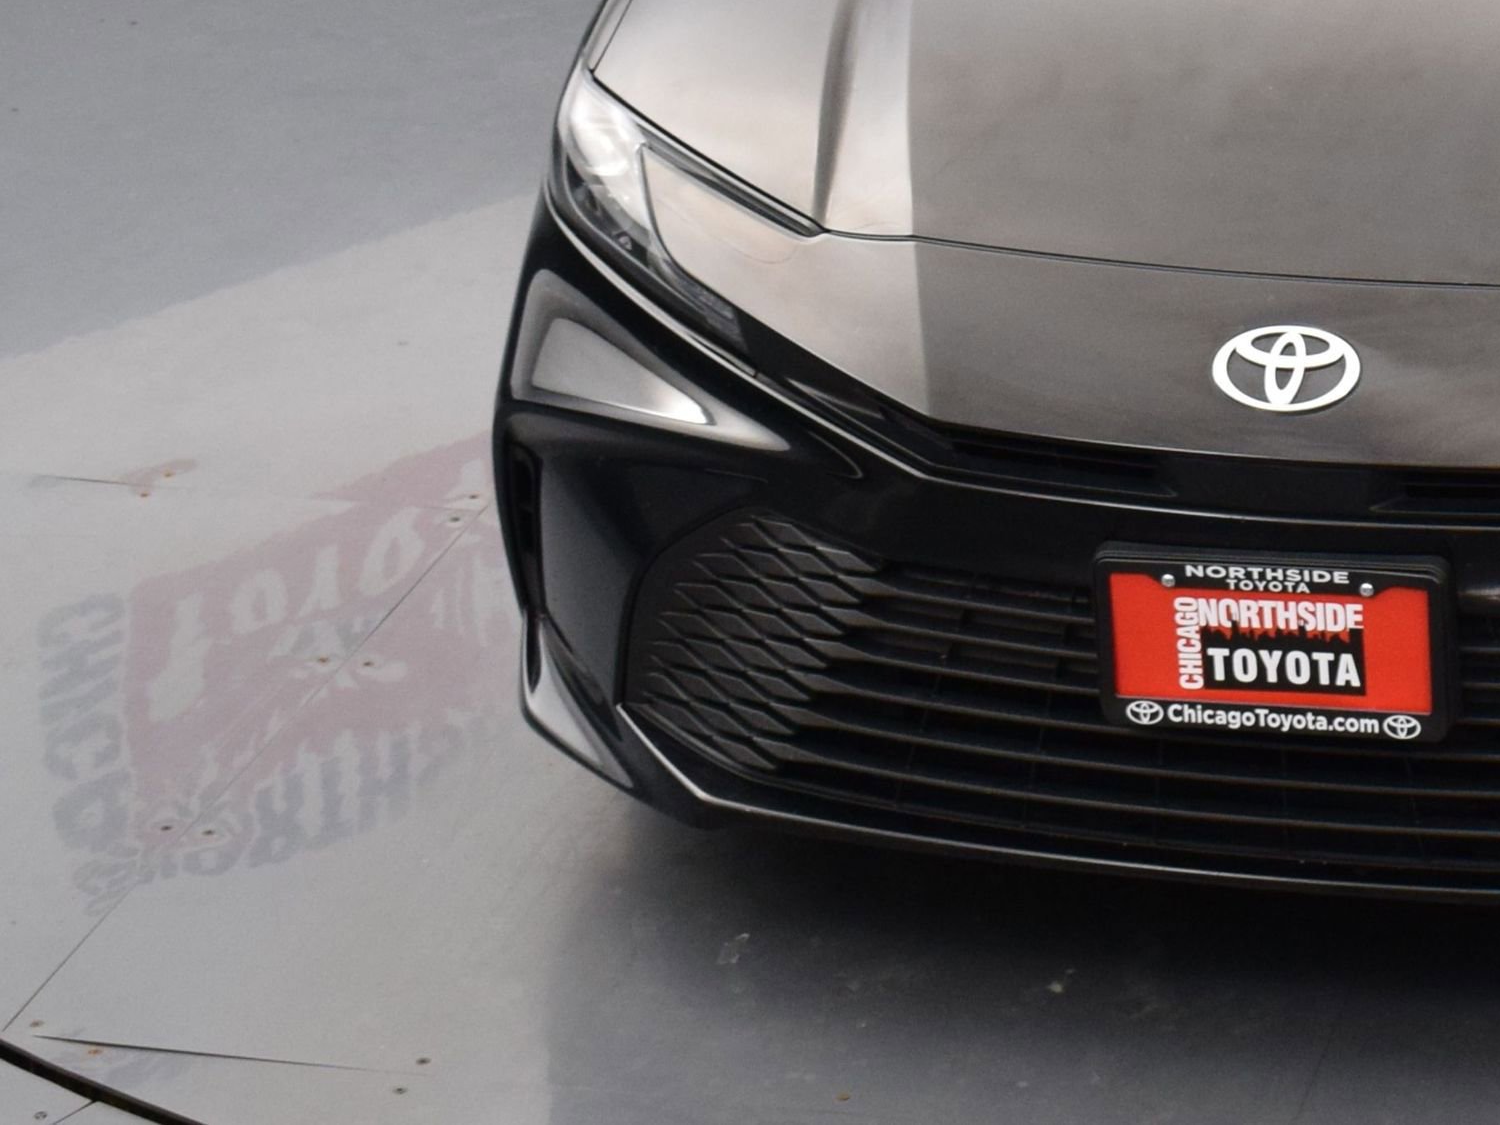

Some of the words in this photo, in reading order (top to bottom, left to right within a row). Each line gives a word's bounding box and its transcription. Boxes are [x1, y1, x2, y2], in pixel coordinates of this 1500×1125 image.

[1185, 565, 1350, 584] NORTHSIDE
[1226, 578, 1311, 593] TOYOTA
[1197, 597, 1364, 632] NORTHSIDE
[1173, 596, 1205, 690] CHICAGO
[1206, 647, 1362, 687] TOYOTA
[1167, 704, 1380, 734] ChicagoToyota.com
